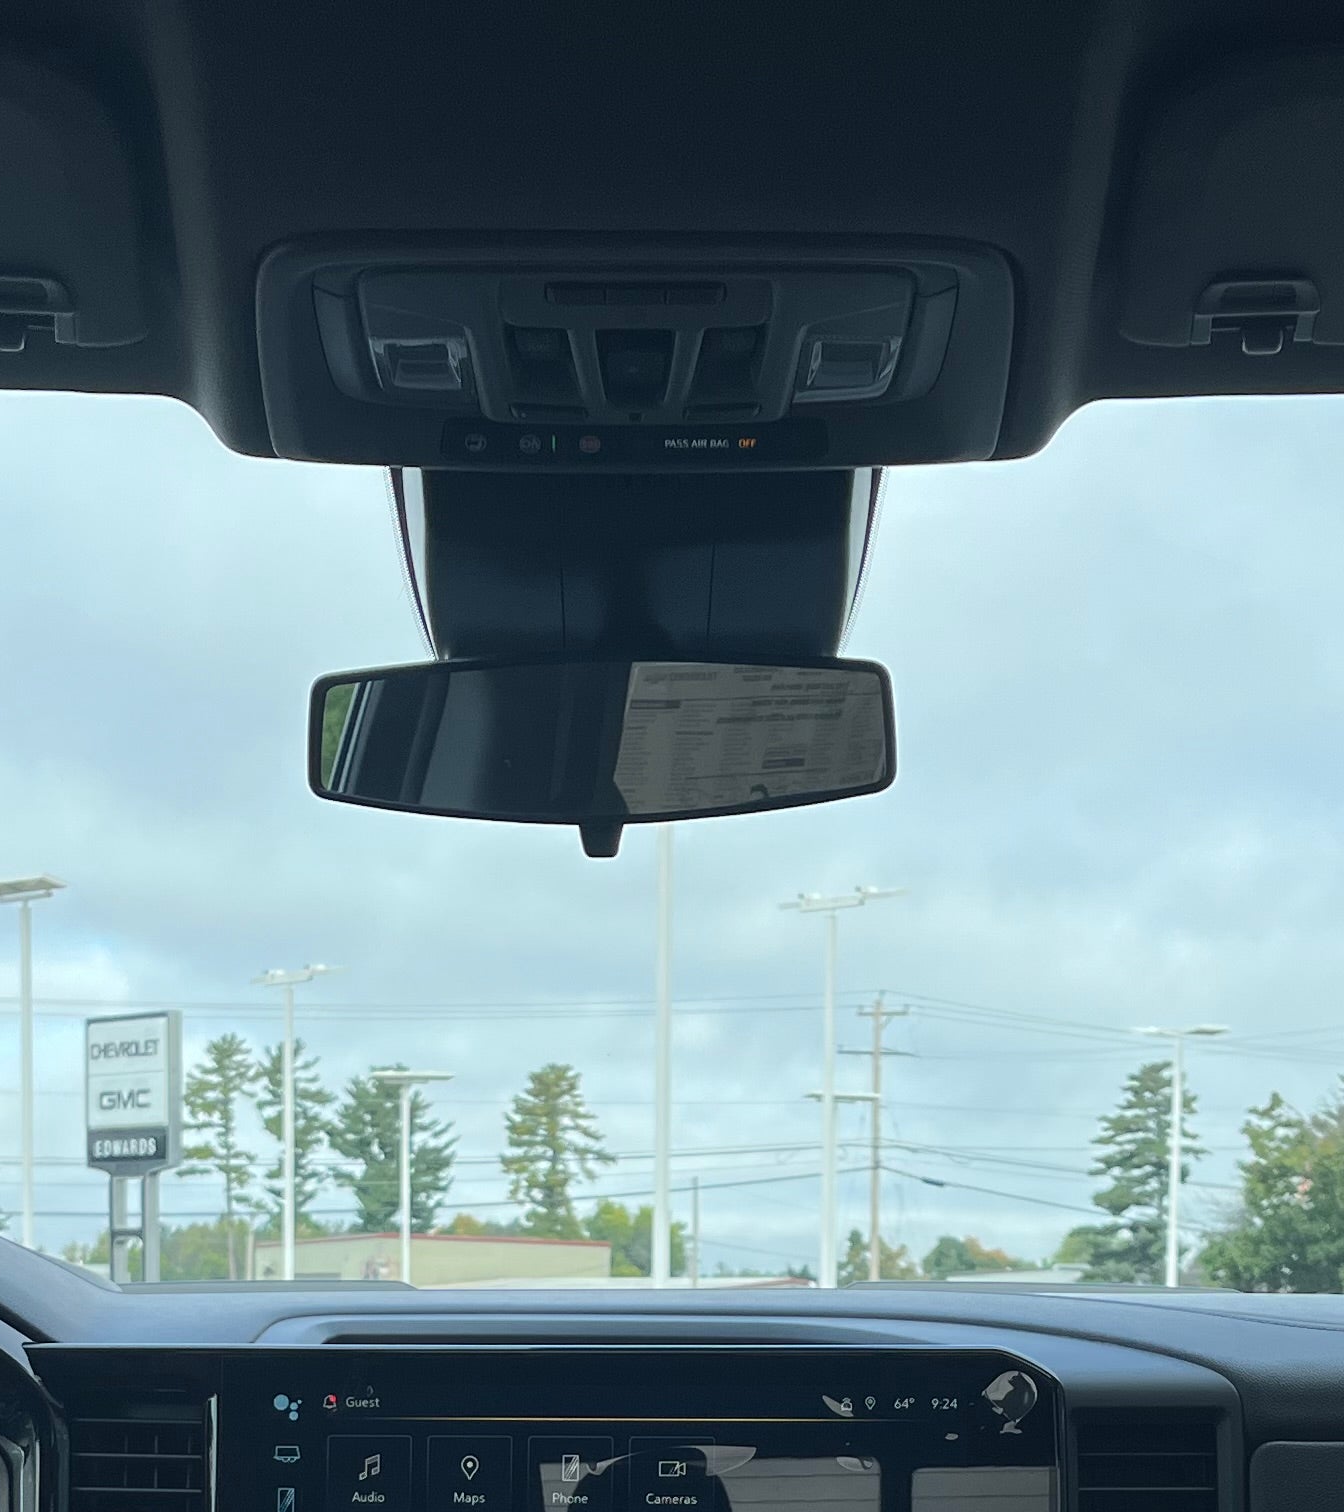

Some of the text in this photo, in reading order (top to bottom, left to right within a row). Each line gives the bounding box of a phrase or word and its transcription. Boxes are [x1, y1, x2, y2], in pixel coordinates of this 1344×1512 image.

[664, 438, 757, 449] PASS AIR BAG OFF
[90, 1038, 160, 1061] CHEVROLET
[99, 1088, 151, 1111] GMC
[93, 1137, 157, 1159] EDWARDS
[345, 1396, 380, 1408] Guest
[893, 1397, 916, 1409] 64°
[931, 1398, 958, 1409] 9:24
[351, 1491, 385, 1503] Audio
[452, 1492, 486, 1505] Maps
[551, 1492, 589, 1504] Phone
[645, 1493, 698, 1505] Cameras
